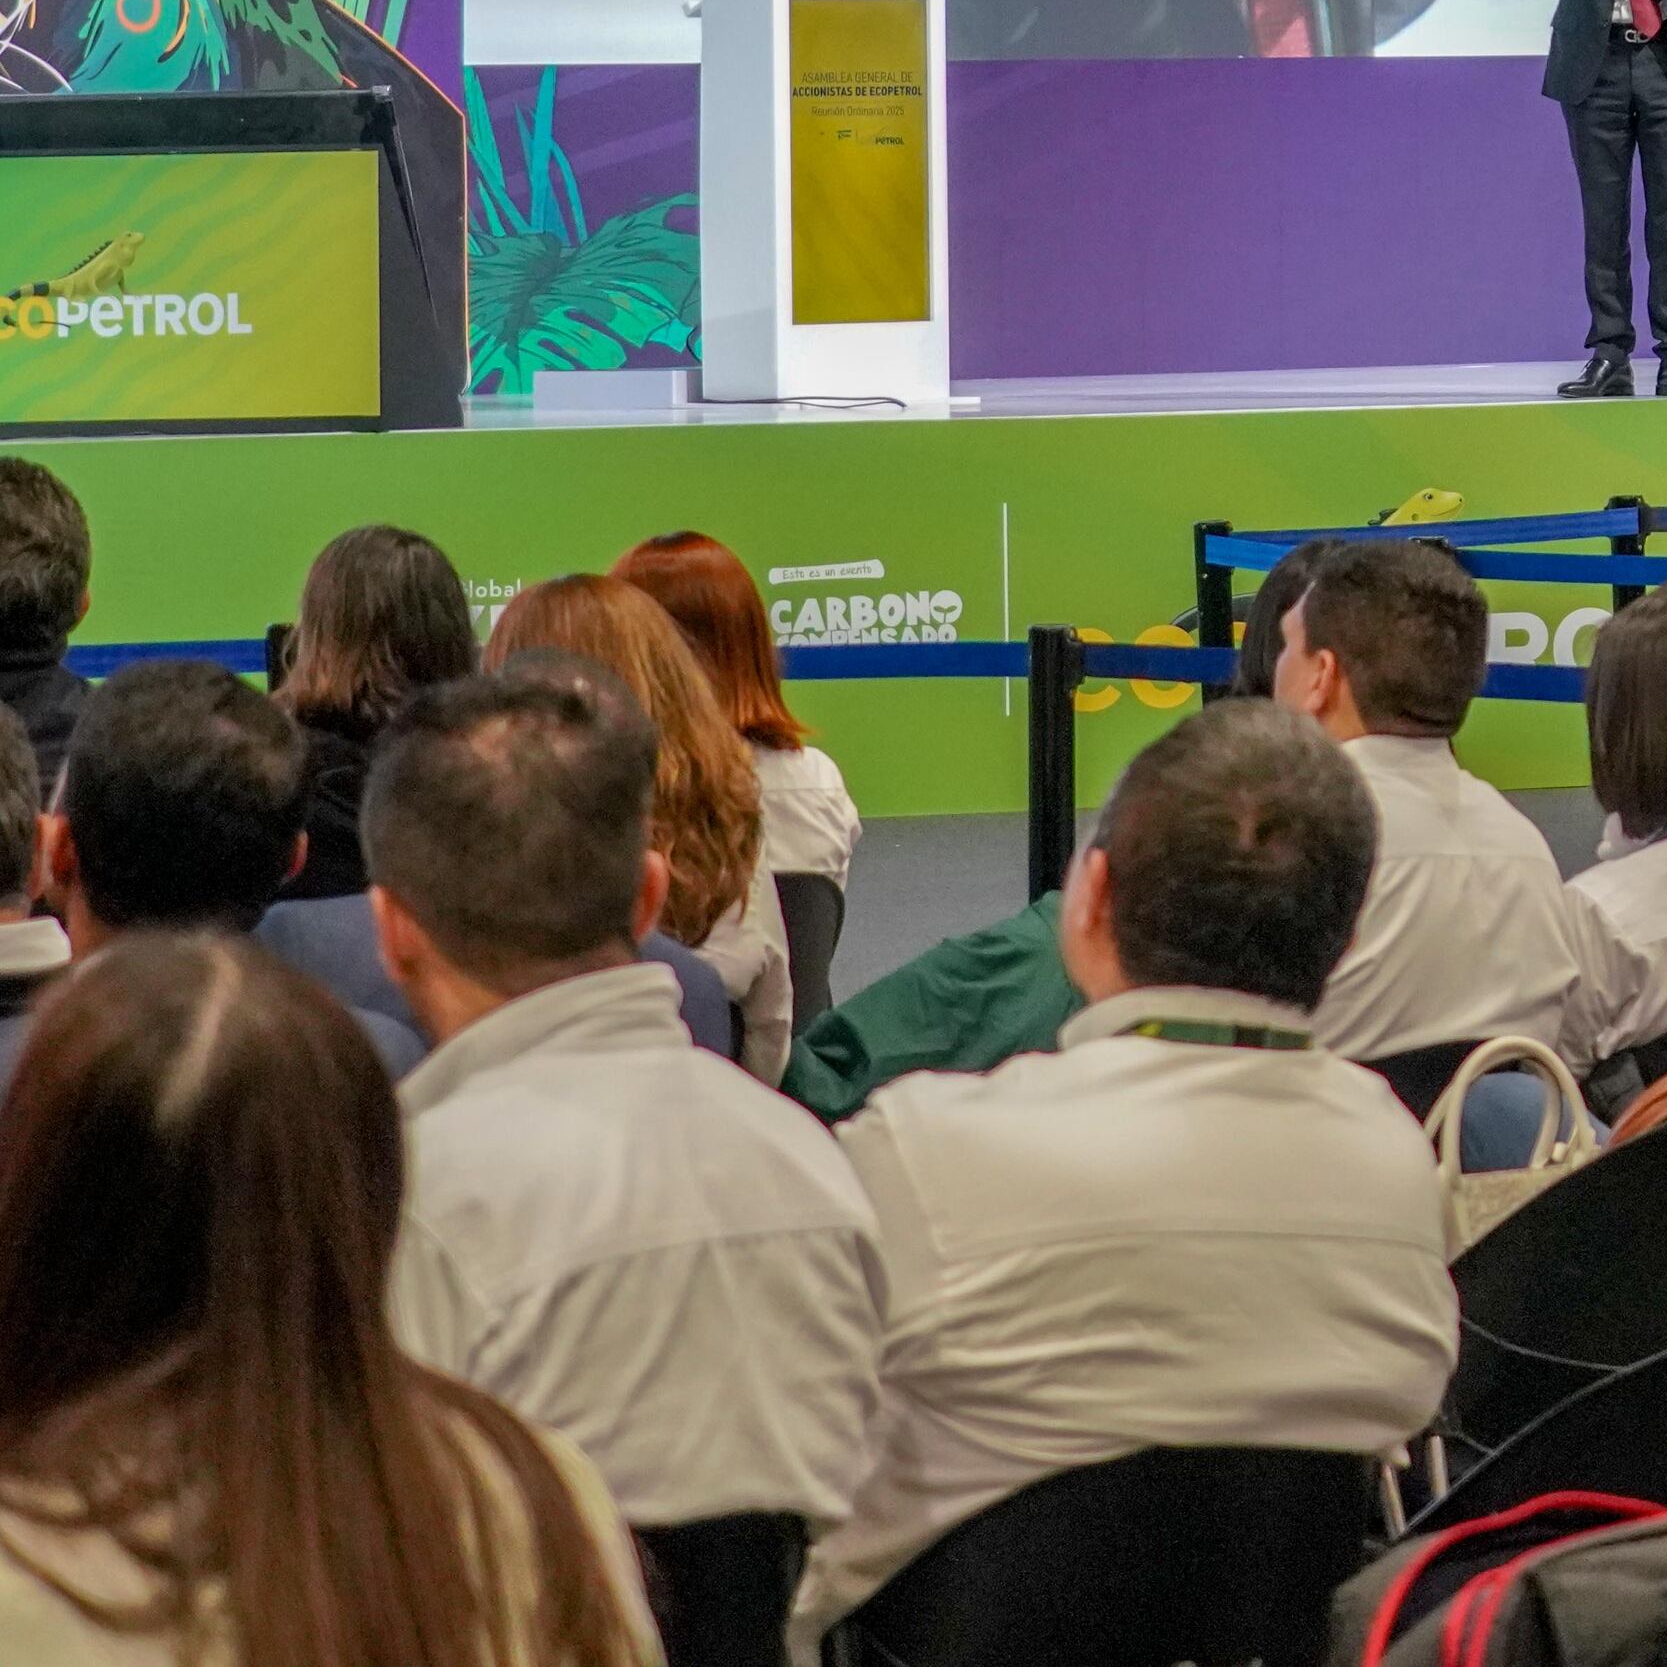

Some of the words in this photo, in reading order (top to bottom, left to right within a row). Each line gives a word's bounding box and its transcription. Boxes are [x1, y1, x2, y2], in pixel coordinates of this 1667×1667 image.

[802, 72, 852, 83] ASAMBLEA
[855, 72, 898, 83] GENERAL
[901, 72, 913, 83] DE
[792, 86, 853, 97] ACCIONISTAS
[855, 86, 867, 97] DE
[870, 86, 923, 96] ECOPETROL
[811, 106, 845, 117] Reunión
[847, 106, 884, 117] Ordinaria
[886, 106, 905, 117] 2025
[782, 569, 805, 580] Esto
[809, 570, 820, 578] es
[825, 568, 836, 577] un
[840, 563, 872, 576] evento
[770, 589, 963, 634] CARBONO
